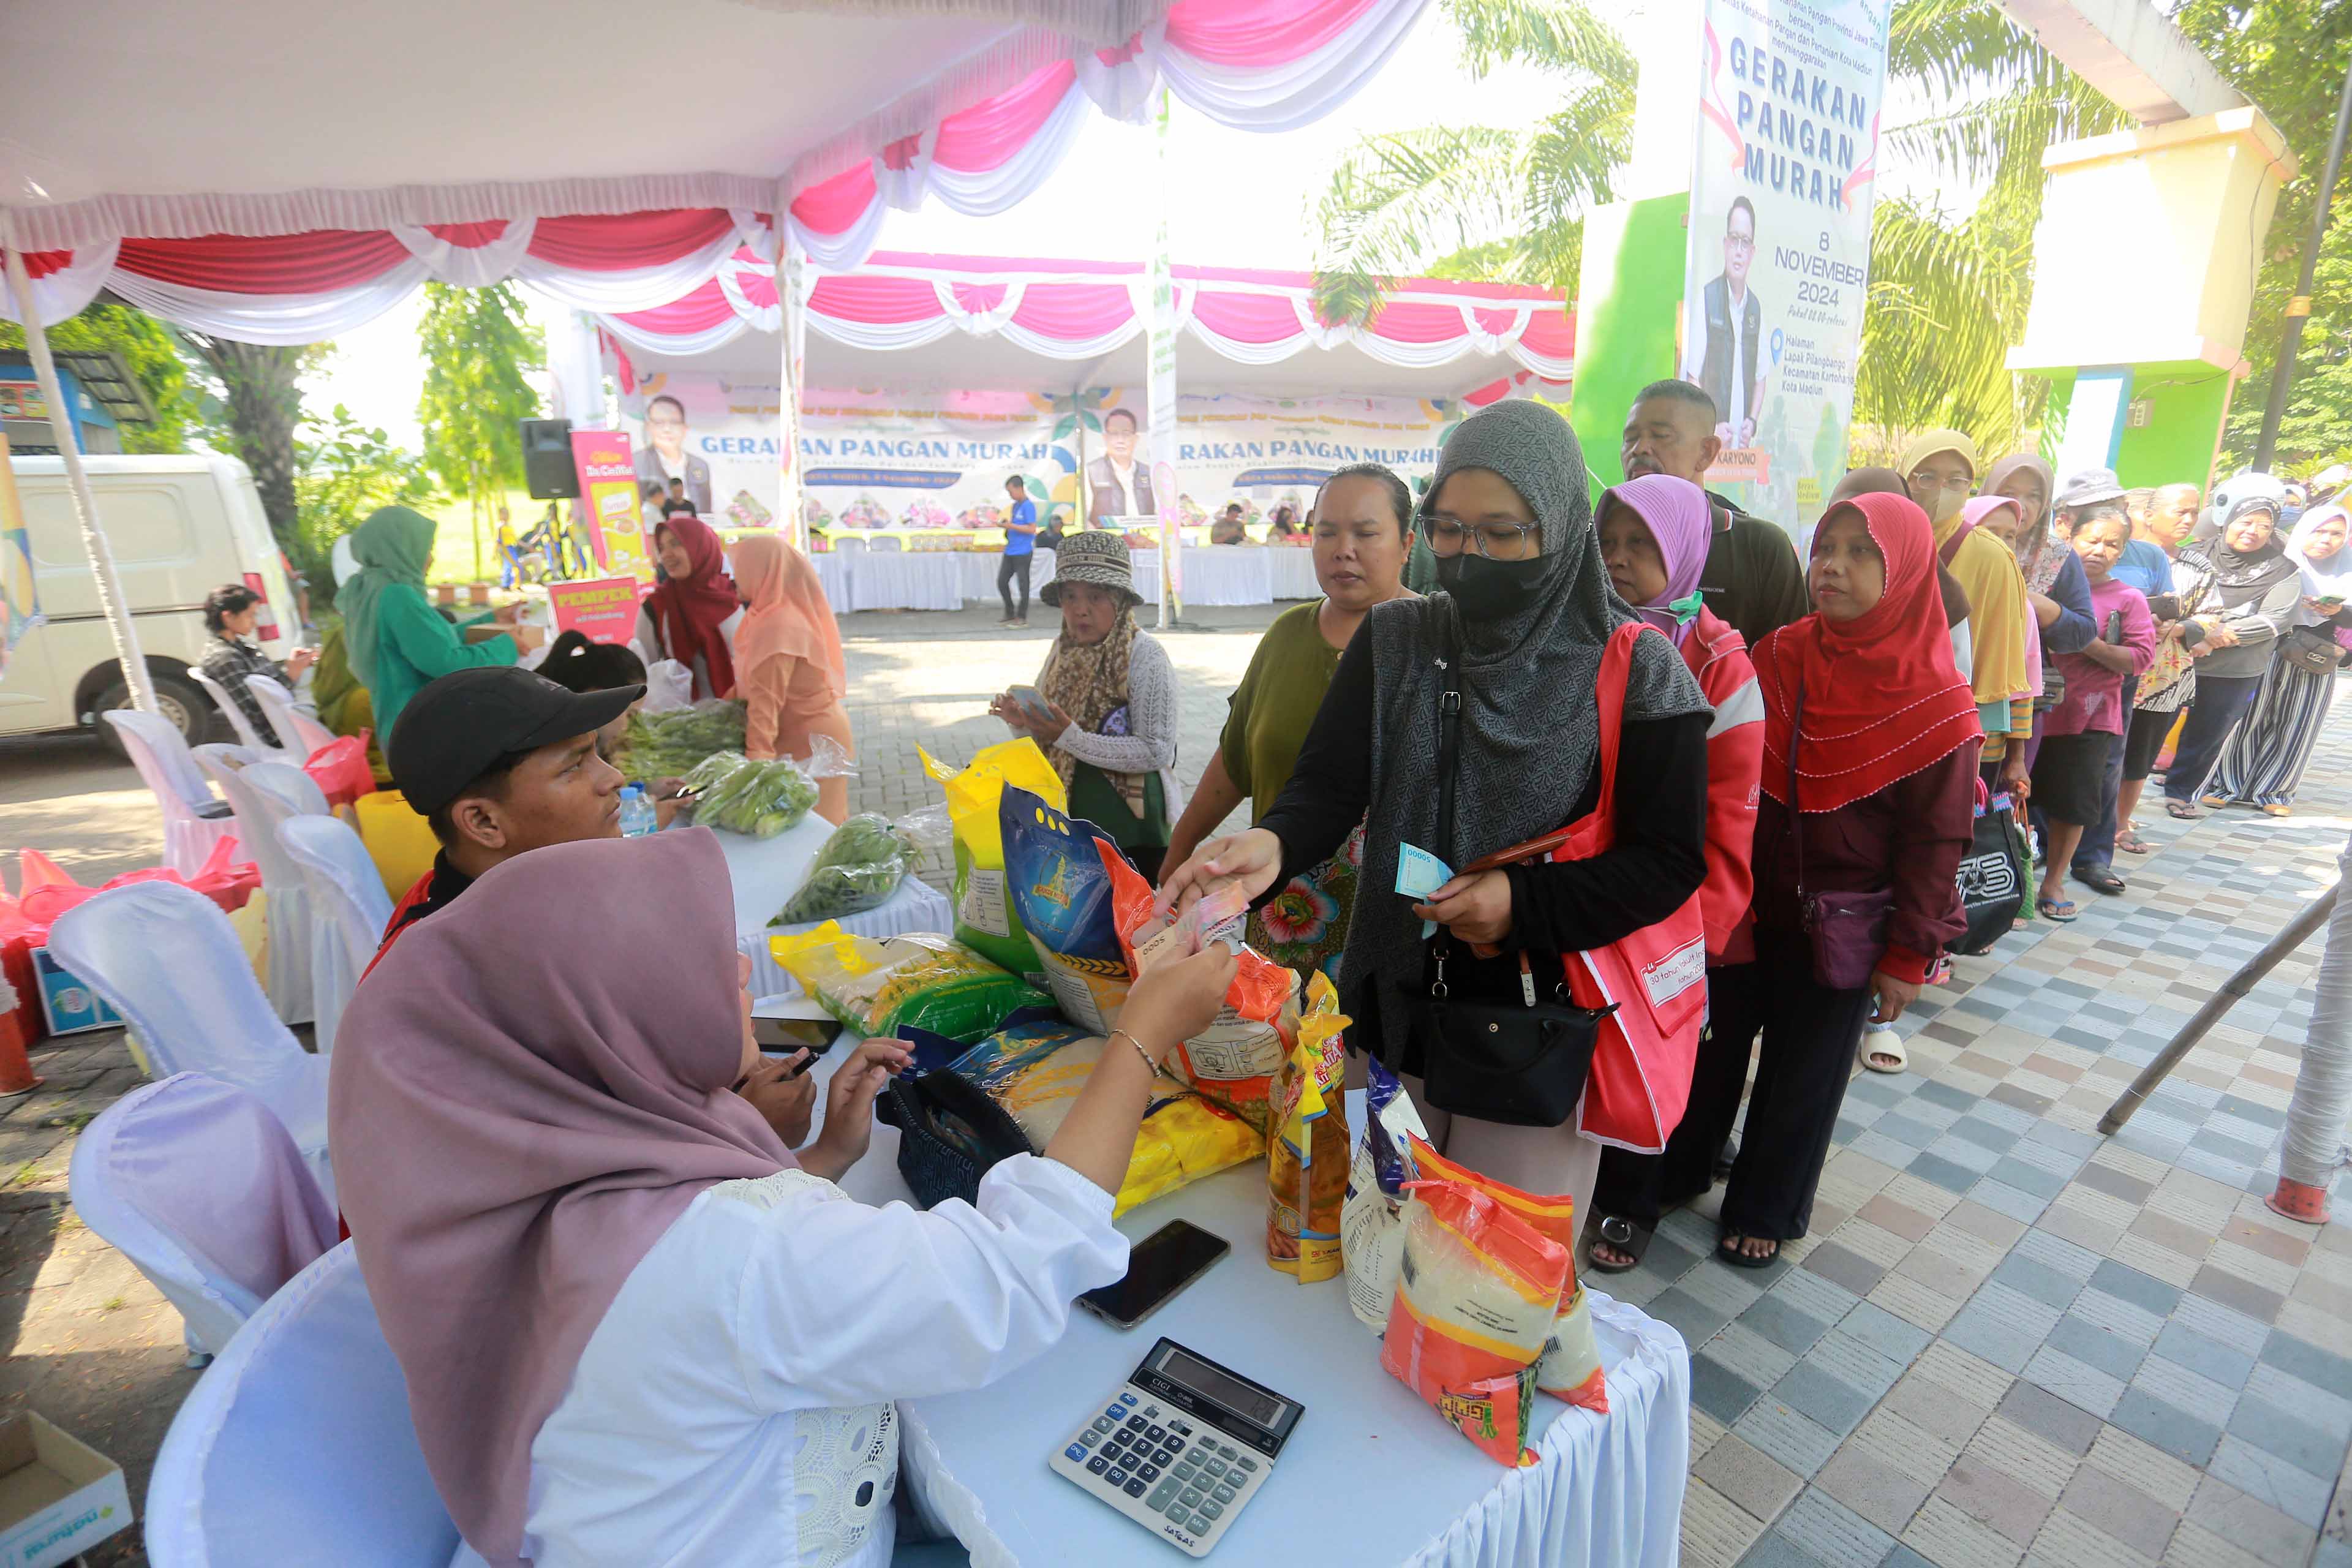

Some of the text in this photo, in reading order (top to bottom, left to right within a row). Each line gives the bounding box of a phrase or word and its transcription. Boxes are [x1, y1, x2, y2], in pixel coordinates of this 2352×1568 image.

[1789, 12, 1814, 34] bersama
[1808, 7, 1831, 25] Pangan
[1854, 32, 1868, 45] Jawa
[1869, 37, 1885, 53] Timur
[1741, 2, 1774, 29] Ketahanan
[1798, 31, 1810, 45] dan
[1811, 39, 1838, 61] Pertanian
[1839, 51, 1852, 66] Kota
[1772, 36, 1826, 70] menyelenggarakan
[1730, 37, 1865, 131] GERAKAN
[1737, 91, 1853, 173] PANGAN
[1744, 143, 1842, 211] MURAH
[1819, 232, 1829, 251] 8
[1775, 246, 1864, 288] NOVEMBER
[1797, 281, 1839, 307] 2024
[1785, 333, 1814, 349] Halaman
[1784, 366, 1819, 380] Kecamatan
[1782, 380, 1797, 393] Kota
[701, 435, 1049, 459] GERAAN PANGAN MURAH
[1180, 440, 1263, 459] RAKAN
[1270, 440, 1358, 461] PANGAN
[1717, 451, 1756, 466] KARYONO
[1407, 849, 1431, 864] 50000
[1650, 974, 1659, 985] 30
[1661, 966, 1679, 980] tahun
[1110, 1406, 1122, 1414] OFF
[1111, 1470, 1122, 1479] 00
[1231, 1472, 1243, 1482] MC
[1218, 1487, 1231, 1496] MR
[1164, 1525, 1195, 1547] SATGAS
